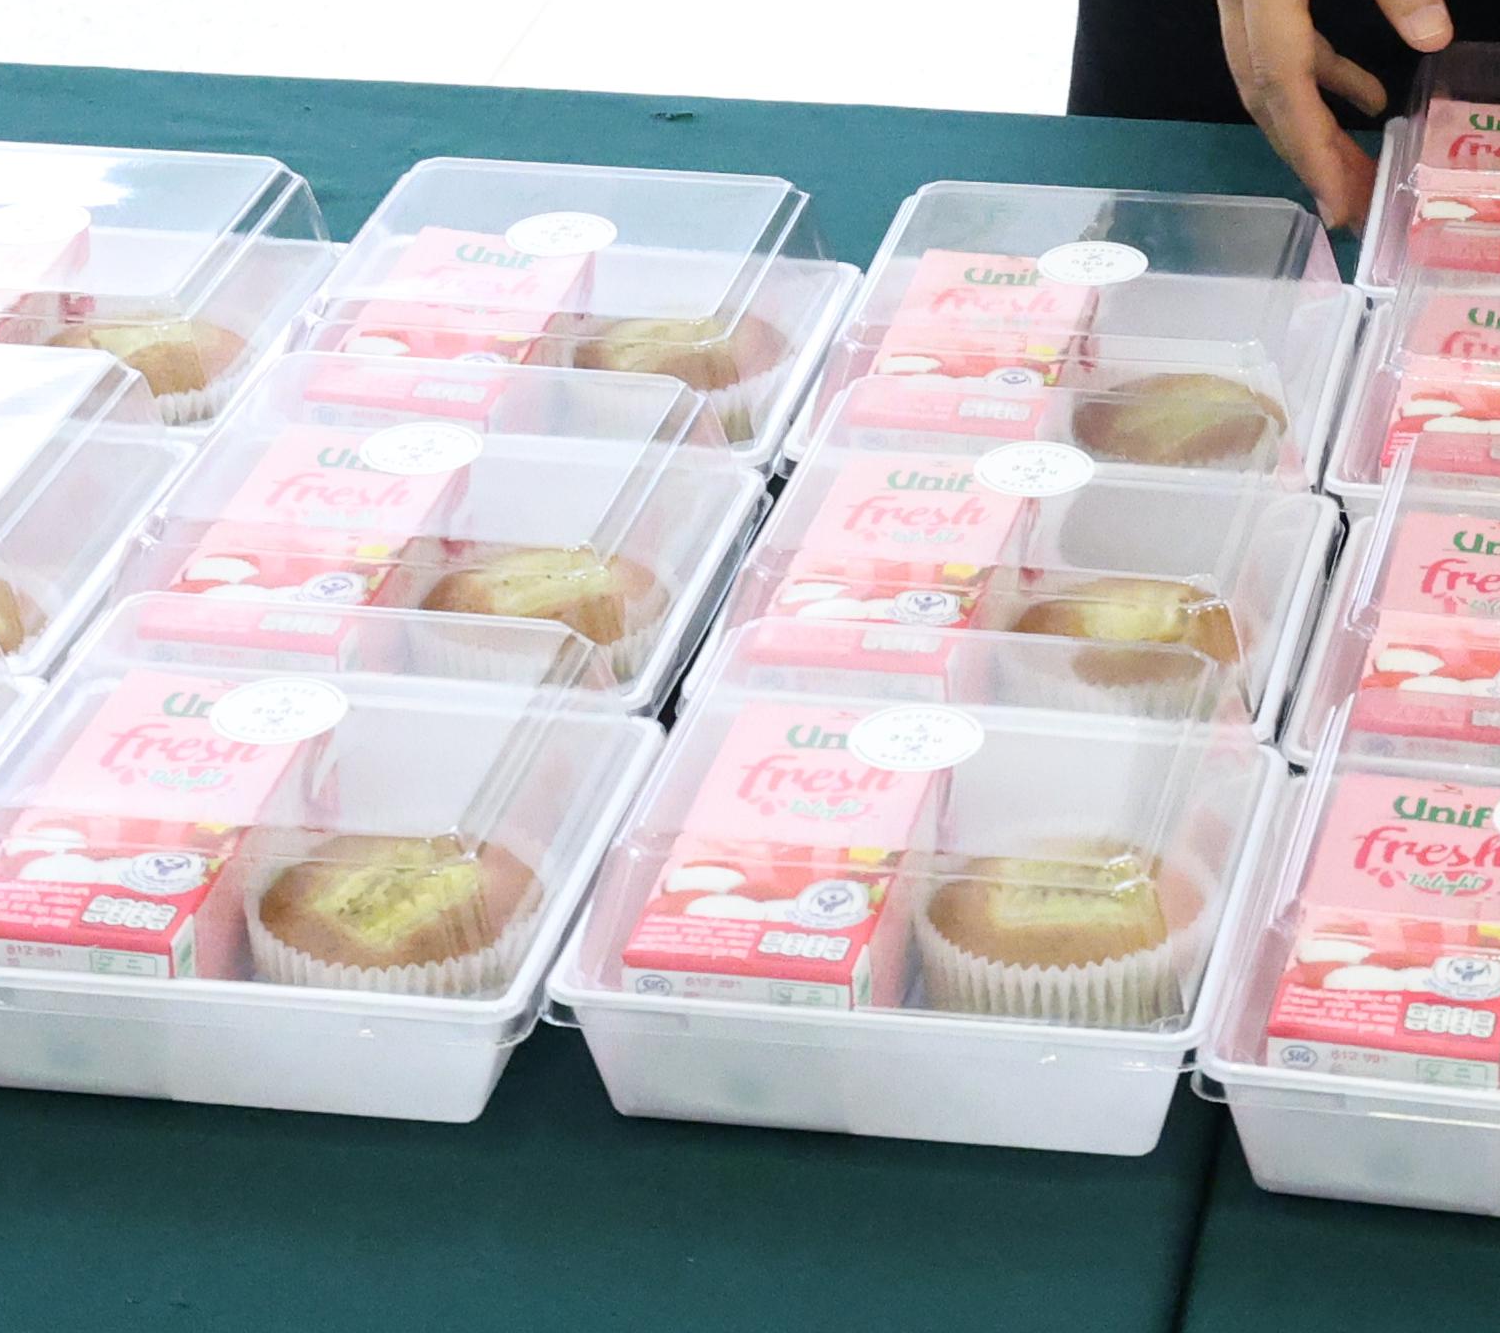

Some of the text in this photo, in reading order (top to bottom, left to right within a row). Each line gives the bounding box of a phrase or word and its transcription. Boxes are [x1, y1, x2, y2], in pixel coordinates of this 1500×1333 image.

[265, 472, 413, 508] fresh
[843, 495, 991, 529] fresh
[1392, 794, 1498, 830] Unif
